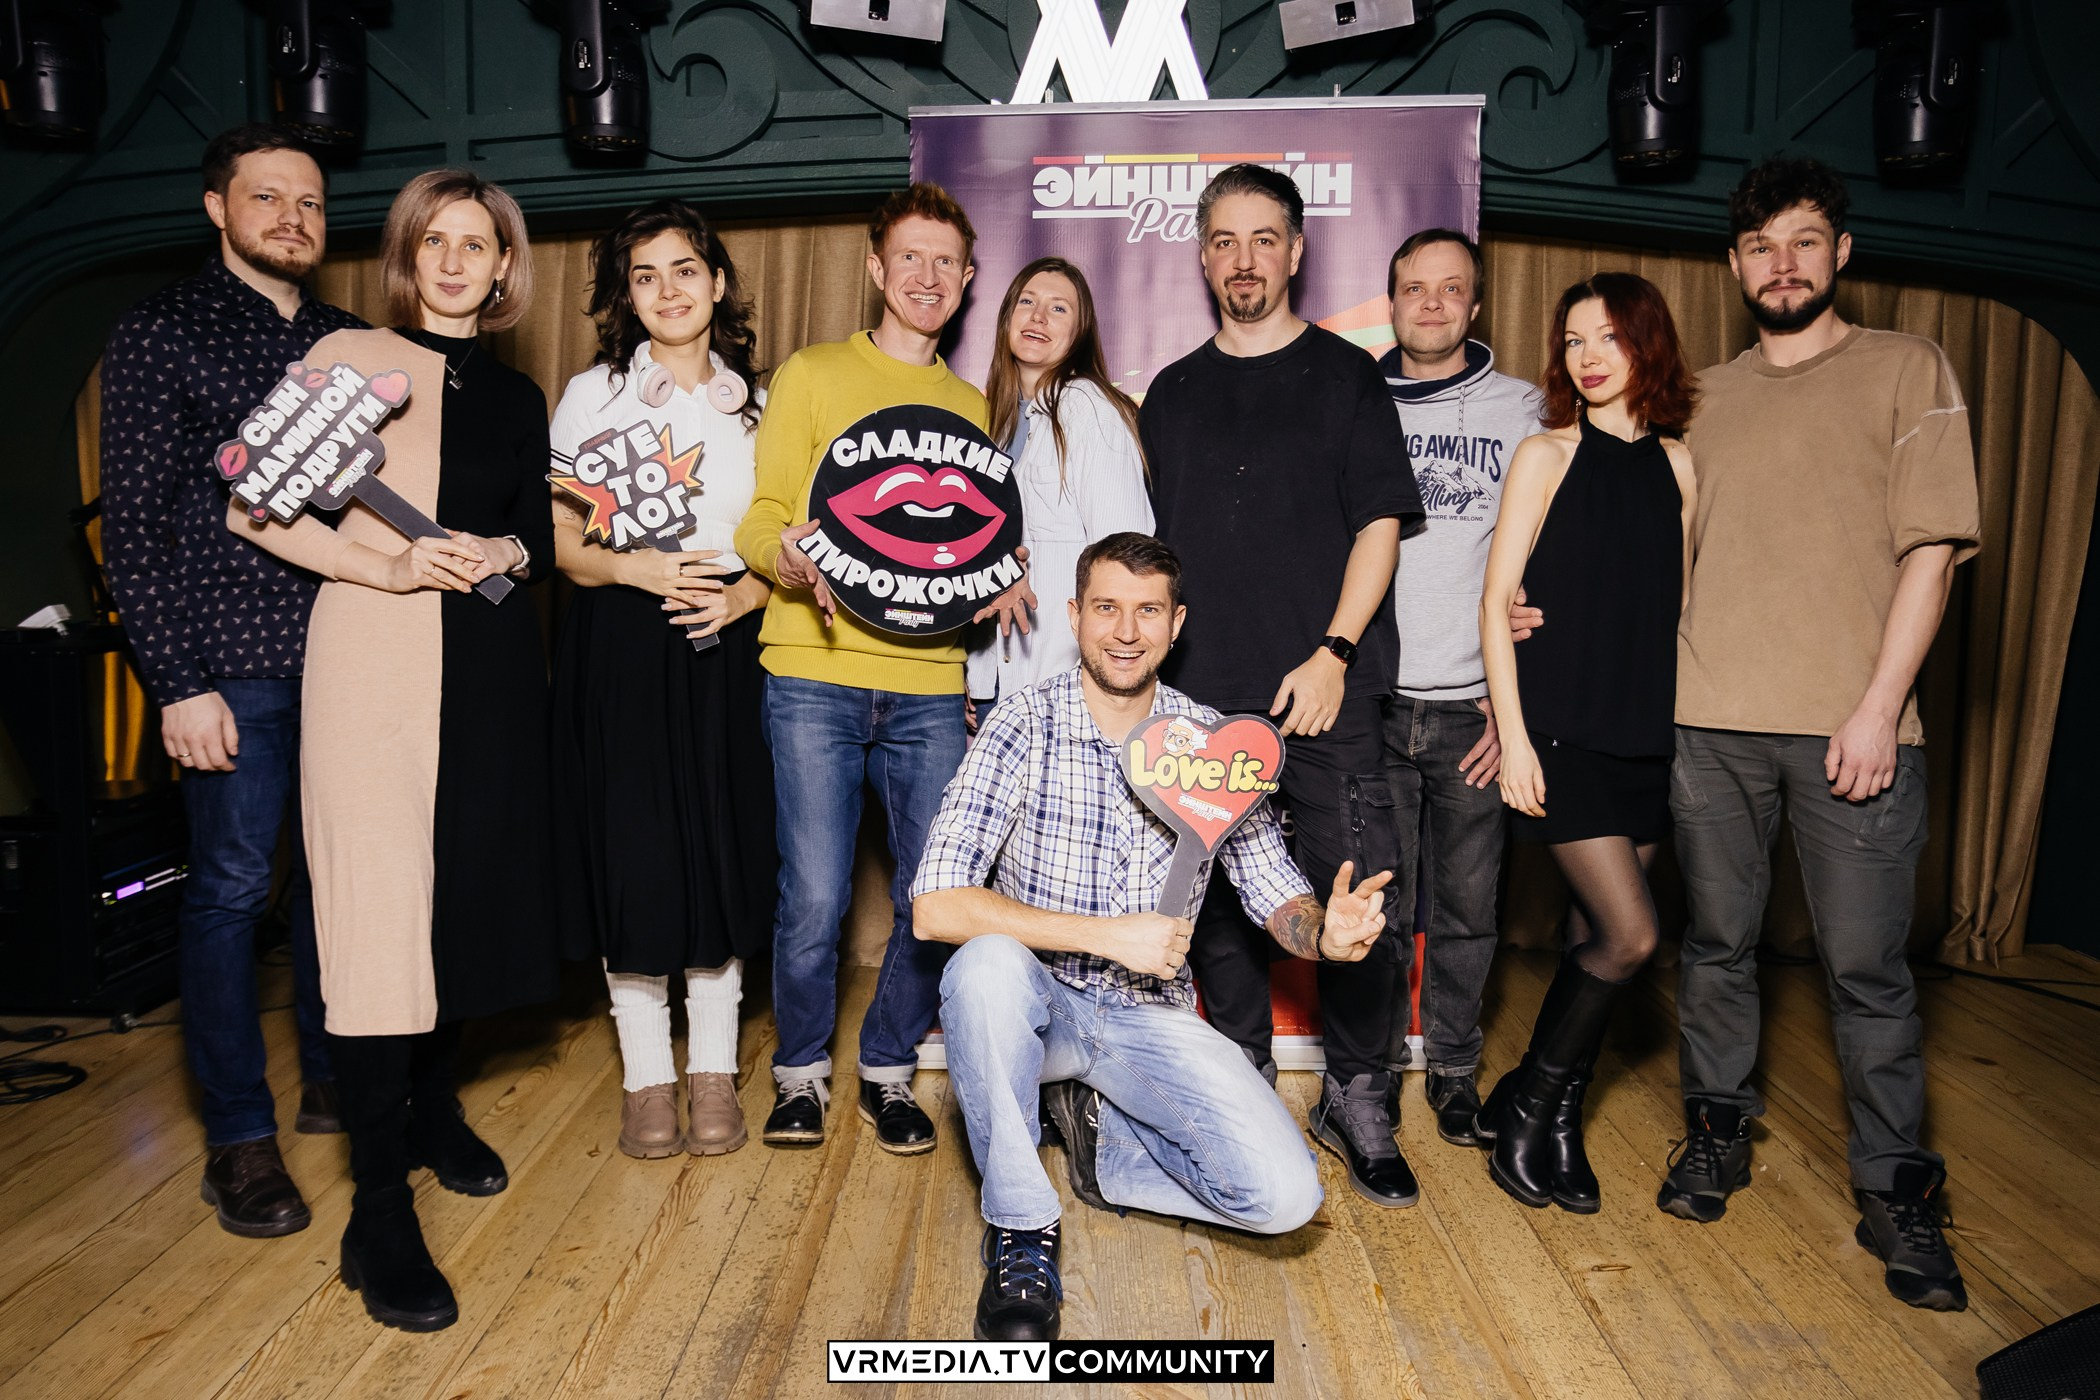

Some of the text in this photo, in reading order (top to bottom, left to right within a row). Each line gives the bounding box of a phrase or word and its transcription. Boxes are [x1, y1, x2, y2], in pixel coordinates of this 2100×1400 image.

[1032, 152, 1352, 208] ЭЙНШЙН
[236, 366, 366, 504] МАМИНОЙ
[243, 380, 310, 447] СЫН
[268, 393, 387, 519] ПОДРУГИ
[575, 423, 661, 485] СУЕ
[607, 462, 668, 507] ТО
[832, 429, 1013, 484] СЛАДКИЕ
[1404, 434, 1503, 483] G AWAITS
[612, 484, 687, 548] ЛОГ
[798, 528, 1024, 605] ПИРОЖОЧКИ
[1130, 739, 1277, 792] Love is...
